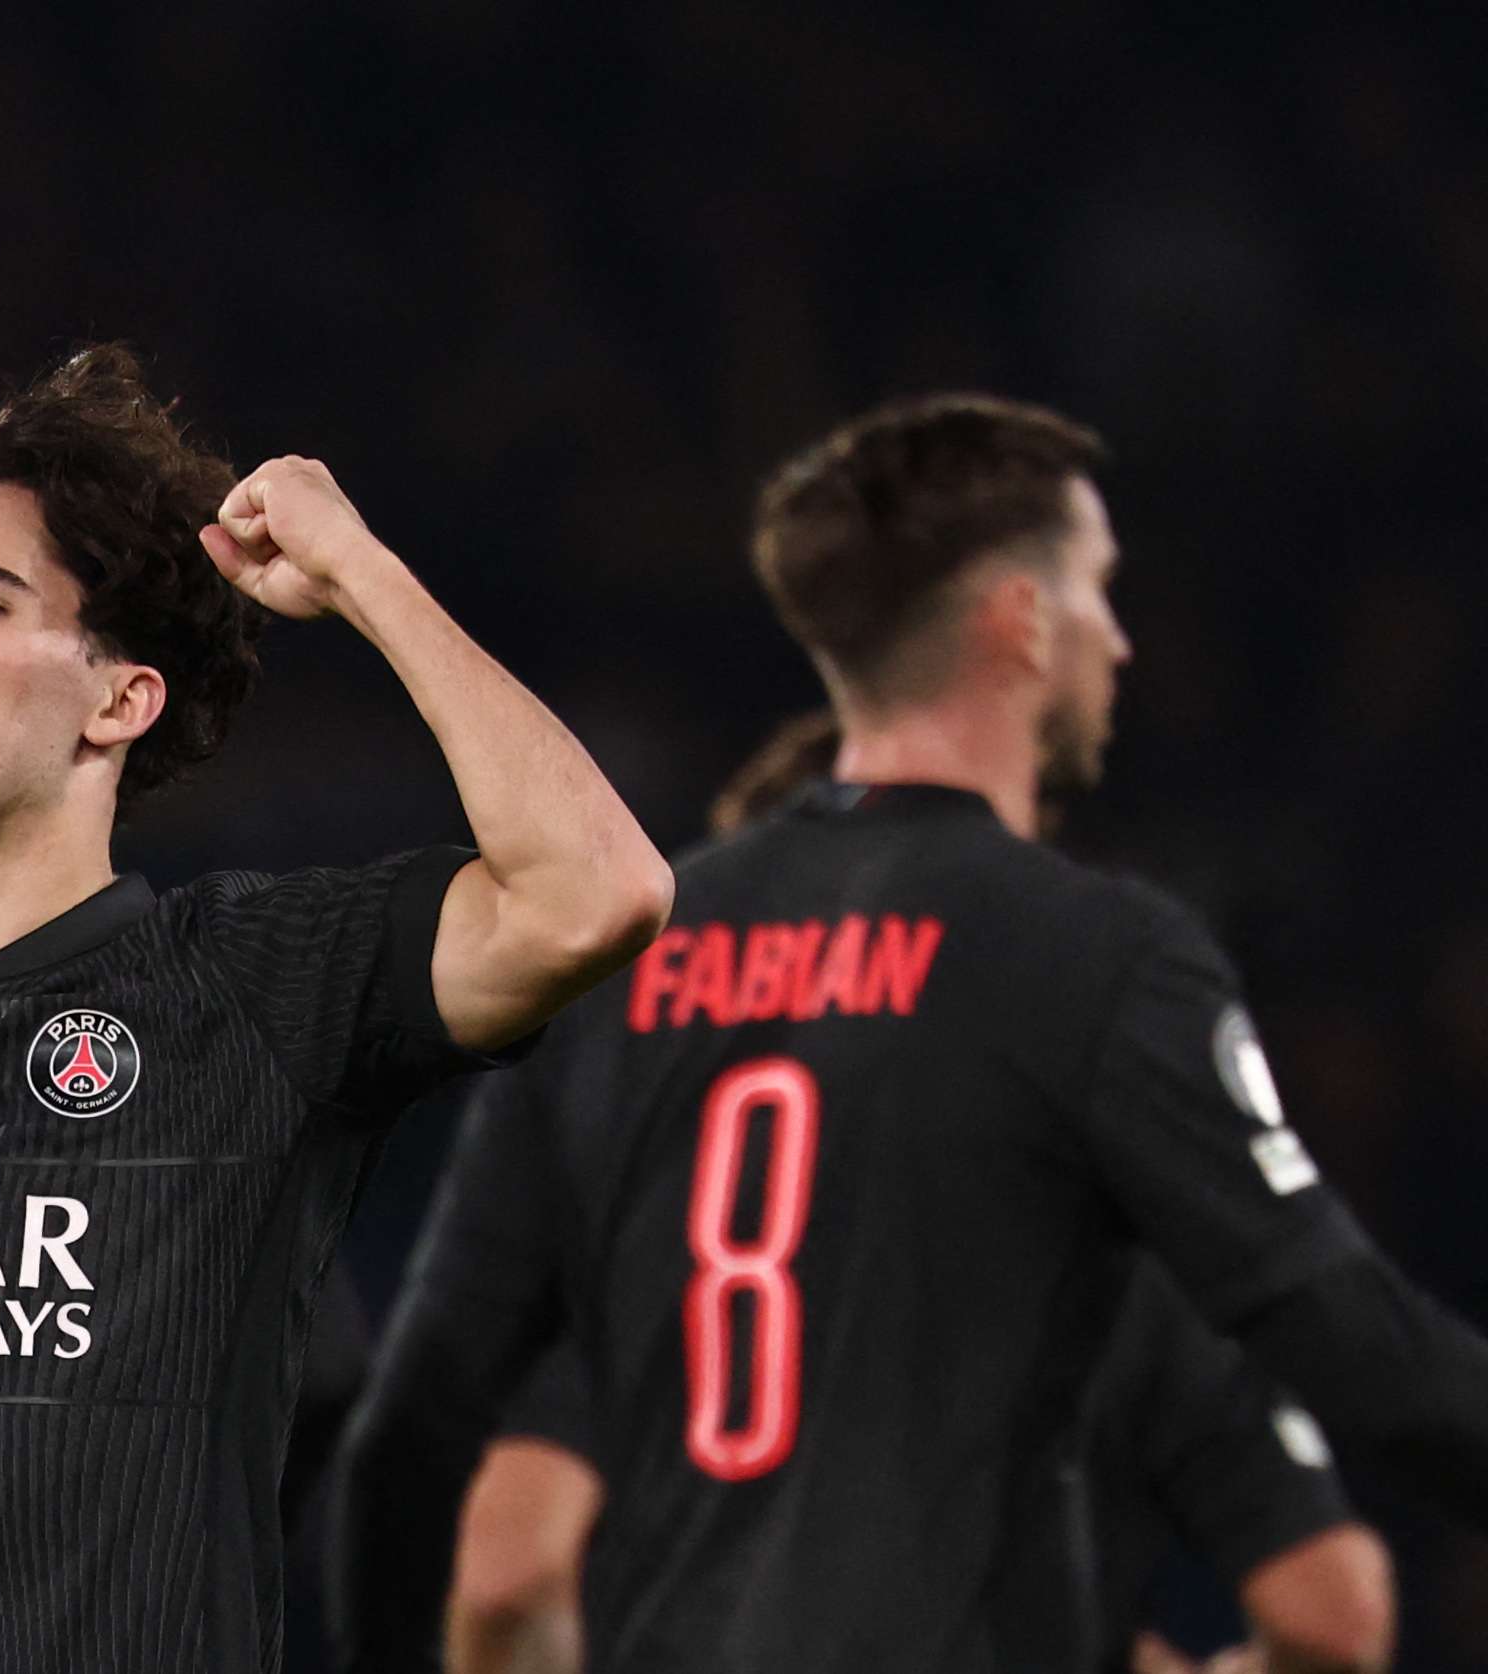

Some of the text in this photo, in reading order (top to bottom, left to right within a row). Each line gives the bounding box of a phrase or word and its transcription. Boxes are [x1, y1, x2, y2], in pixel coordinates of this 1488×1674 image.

[47, 1014, 122, 1043] PARIS
[626, 912, 946, 1033] FABIAN
[681, 1053, 823, 1483] 8
